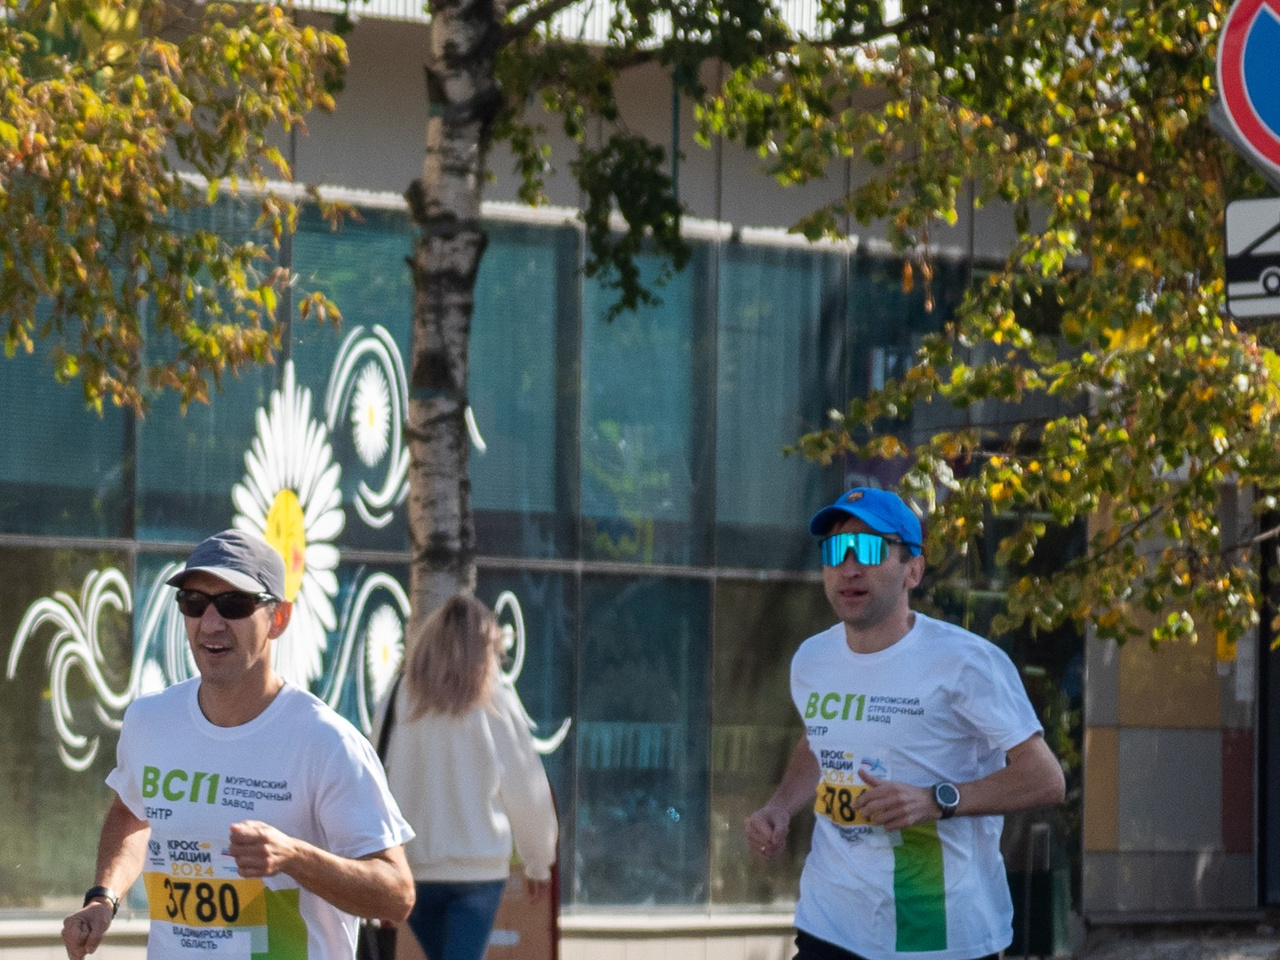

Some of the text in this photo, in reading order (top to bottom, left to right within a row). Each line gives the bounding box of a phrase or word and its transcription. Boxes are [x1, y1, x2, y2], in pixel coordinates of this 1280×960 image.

[807, 725, 828, 736] ЕНТР
[225, 776, 287, 789] МУРОМСКИЙ
[223, 787, 292, 801] СТРЕЛОЧНЫЙ
[221, 798, 255, 811] ЗАВОД
[145, 807, 173, 820] ЕНТР
[167, 840, 199, 851] КРОСС
[169, 851, 211, 863] НАЦИИ
[171, 862, 214, 876] 2024
[164, 878, 239, 923] 3780
[181, 938, 218, 949] ОБЛАСТЬ
